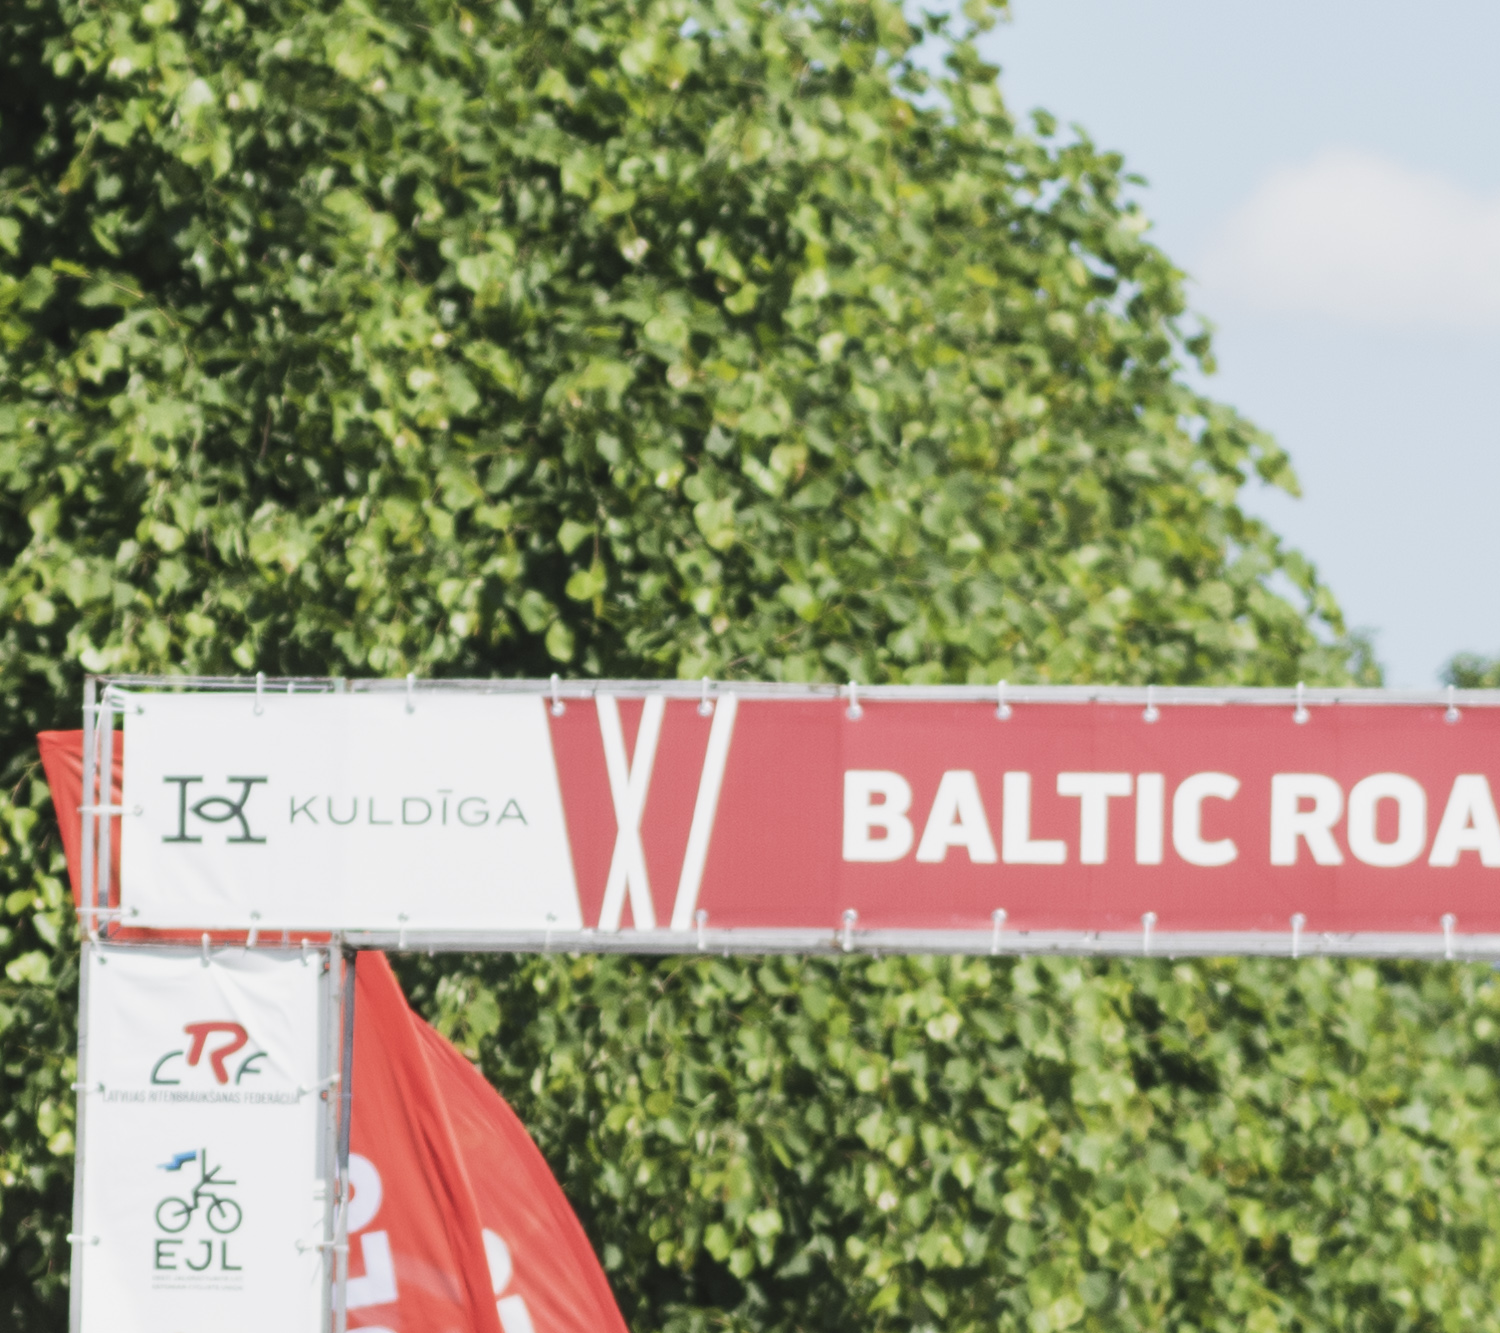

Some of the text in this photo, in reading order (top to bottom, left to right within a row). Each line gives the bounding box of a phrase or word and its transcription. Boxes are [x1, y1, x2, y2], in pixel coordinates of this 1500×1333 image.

[288, 789, 530, 828] KULDĪGA
[842, 768, 1241, 866] BALTIC
[154, 1238, 243, 1272] EJL
